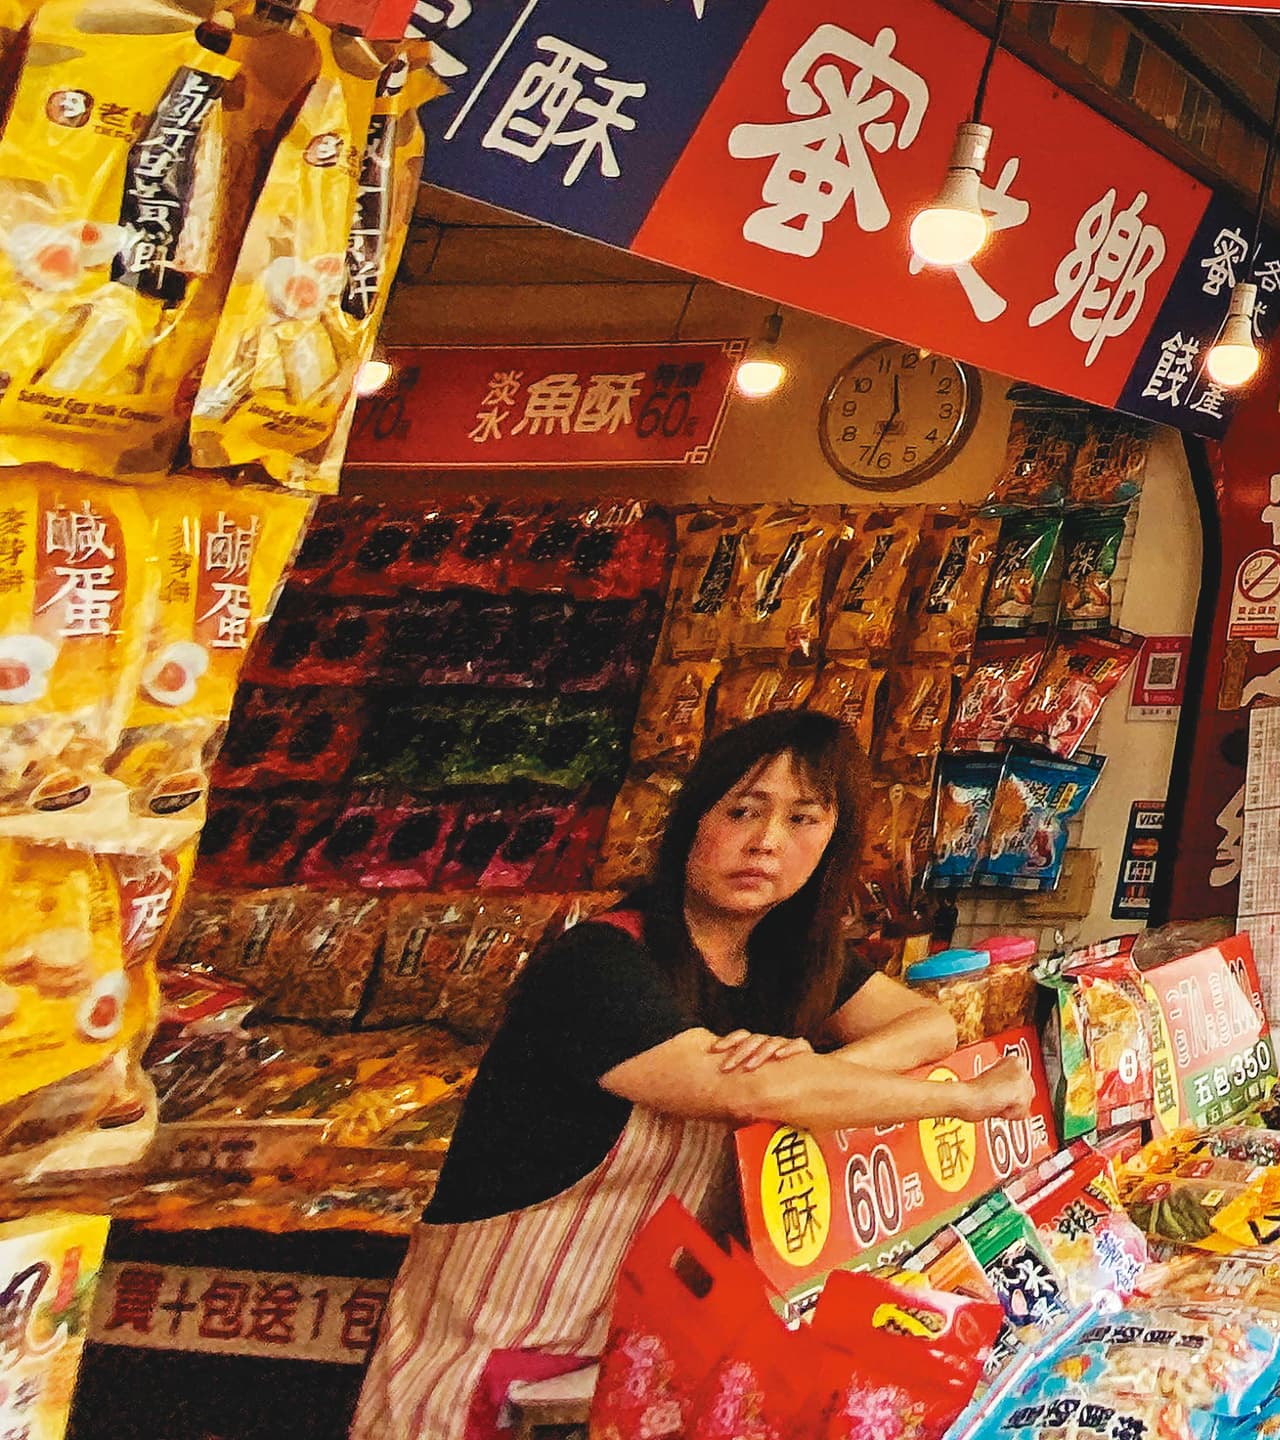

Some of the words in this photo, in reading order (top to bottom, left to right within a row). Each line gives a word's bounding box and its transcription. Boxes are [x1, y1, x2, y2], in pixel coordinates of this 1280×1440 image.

[878, 355, 891, 374] 11
[901, 353, 919, 369] 12
[854, 377, 873, 394] 10
[937, 377, 952, 395] 2
[510, 371, 647, 436] 魚酥
[842, 401, 857, 417] 9
[939, 403, 953, 420] 3
[842, 426, 857, 442] 8
[925, 428, 939, 442] 4
[859, 445, 872, 462] 7
[877, 452, 892, 470] 6
[903, 446, 918, 463] 5
[770, 1128, 821, 1254] 魚酥
